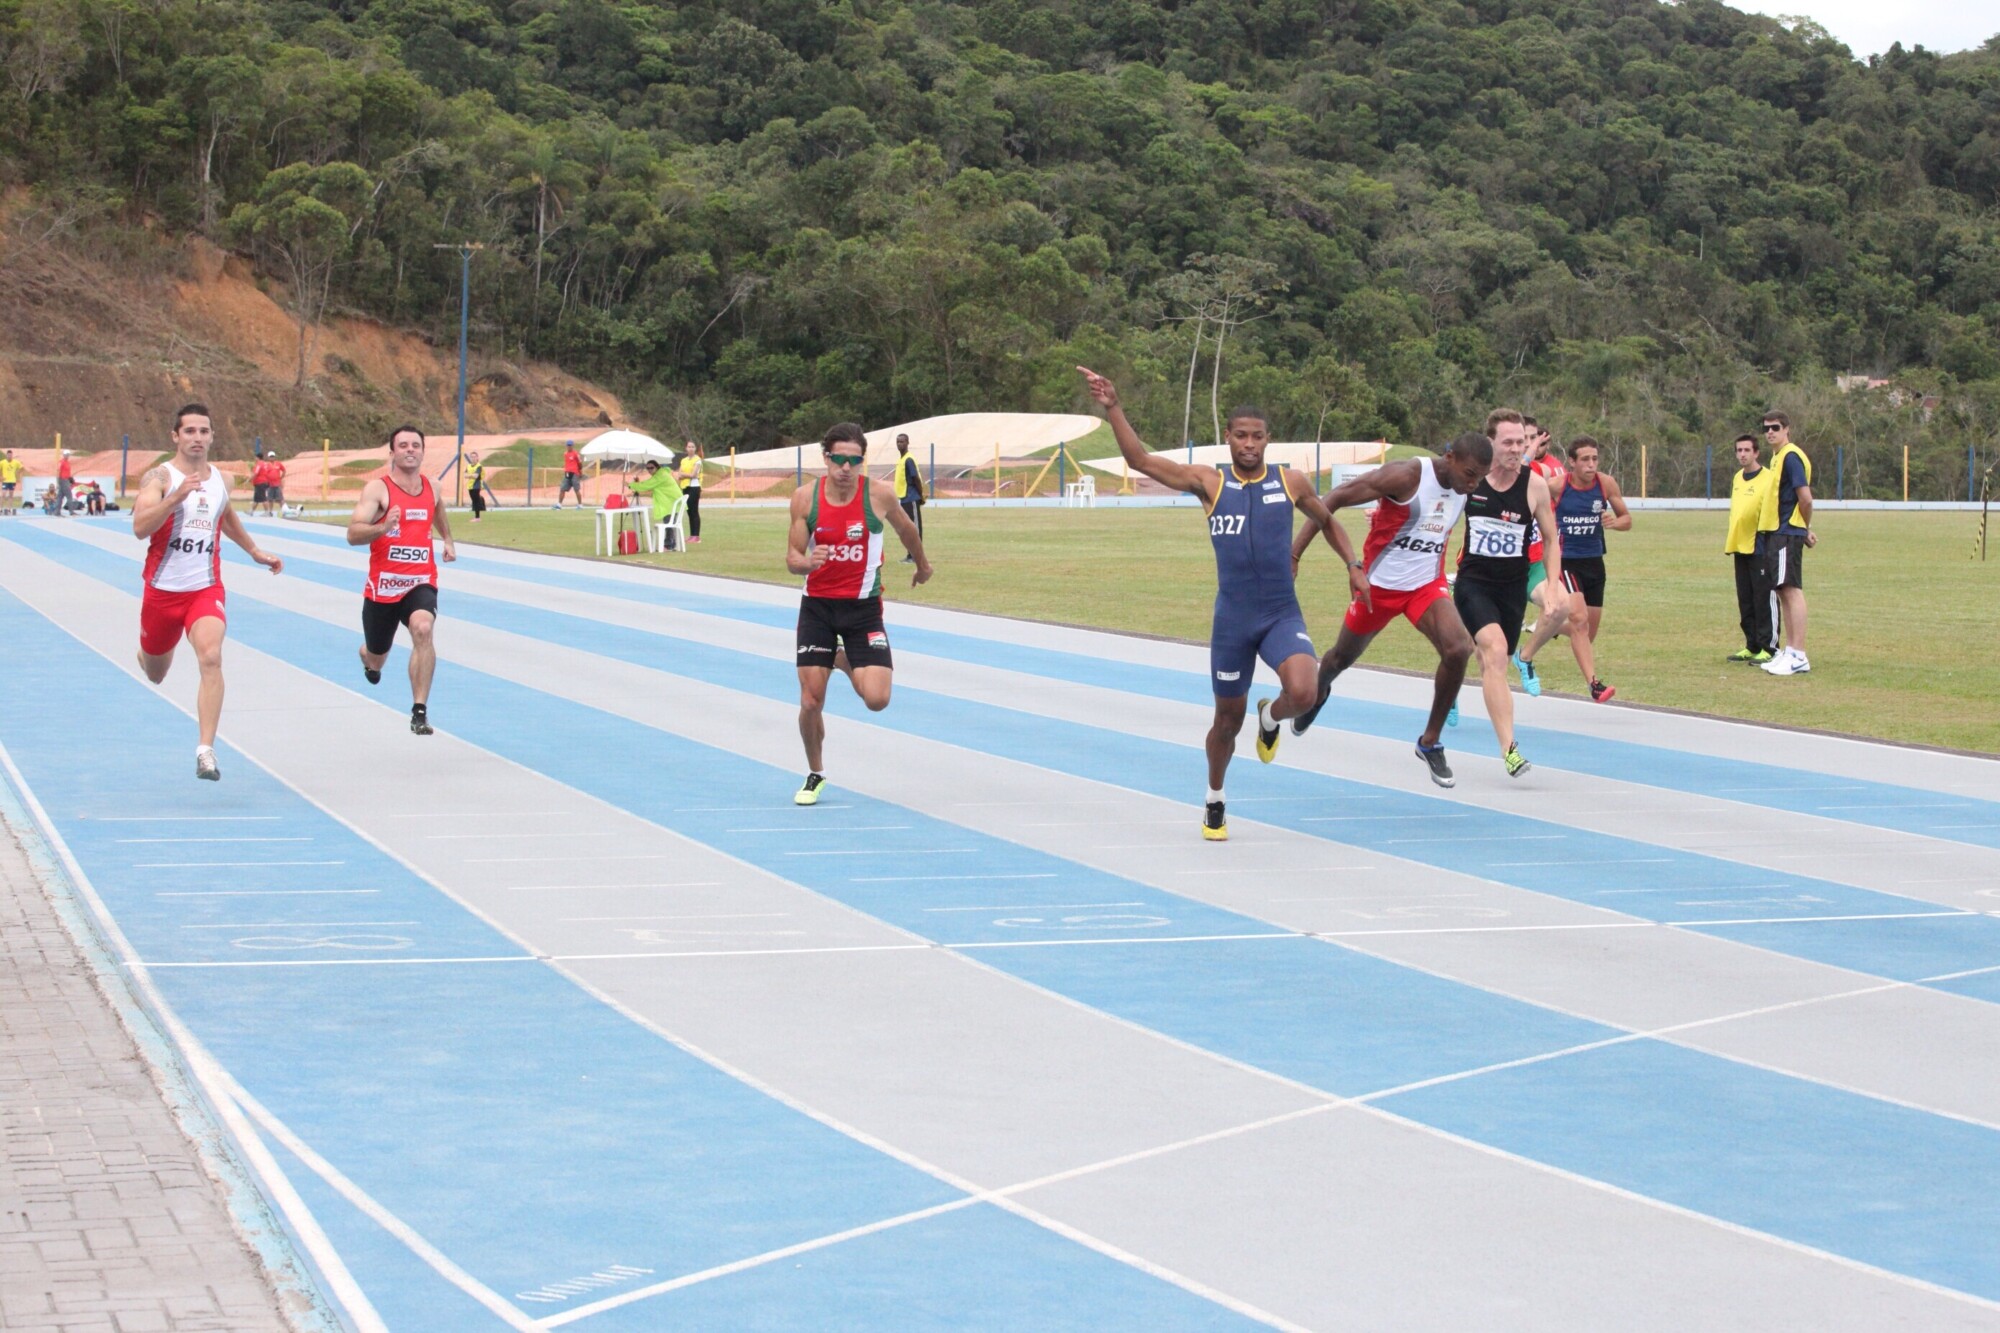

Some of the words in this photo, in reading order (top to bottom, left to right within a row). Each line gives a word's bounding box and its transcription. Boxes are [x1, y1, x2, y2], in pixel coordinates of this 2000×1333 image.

[1210, 515, 1246, 535] 2327
[1567, 525, 1596, 535] 1277
[169, 537, 214, 555] 4614
[1394, 536, 1444, 554] 4620
[1475, 530, 1517, 555] 768
[389, 547, 429, 561] 2590
